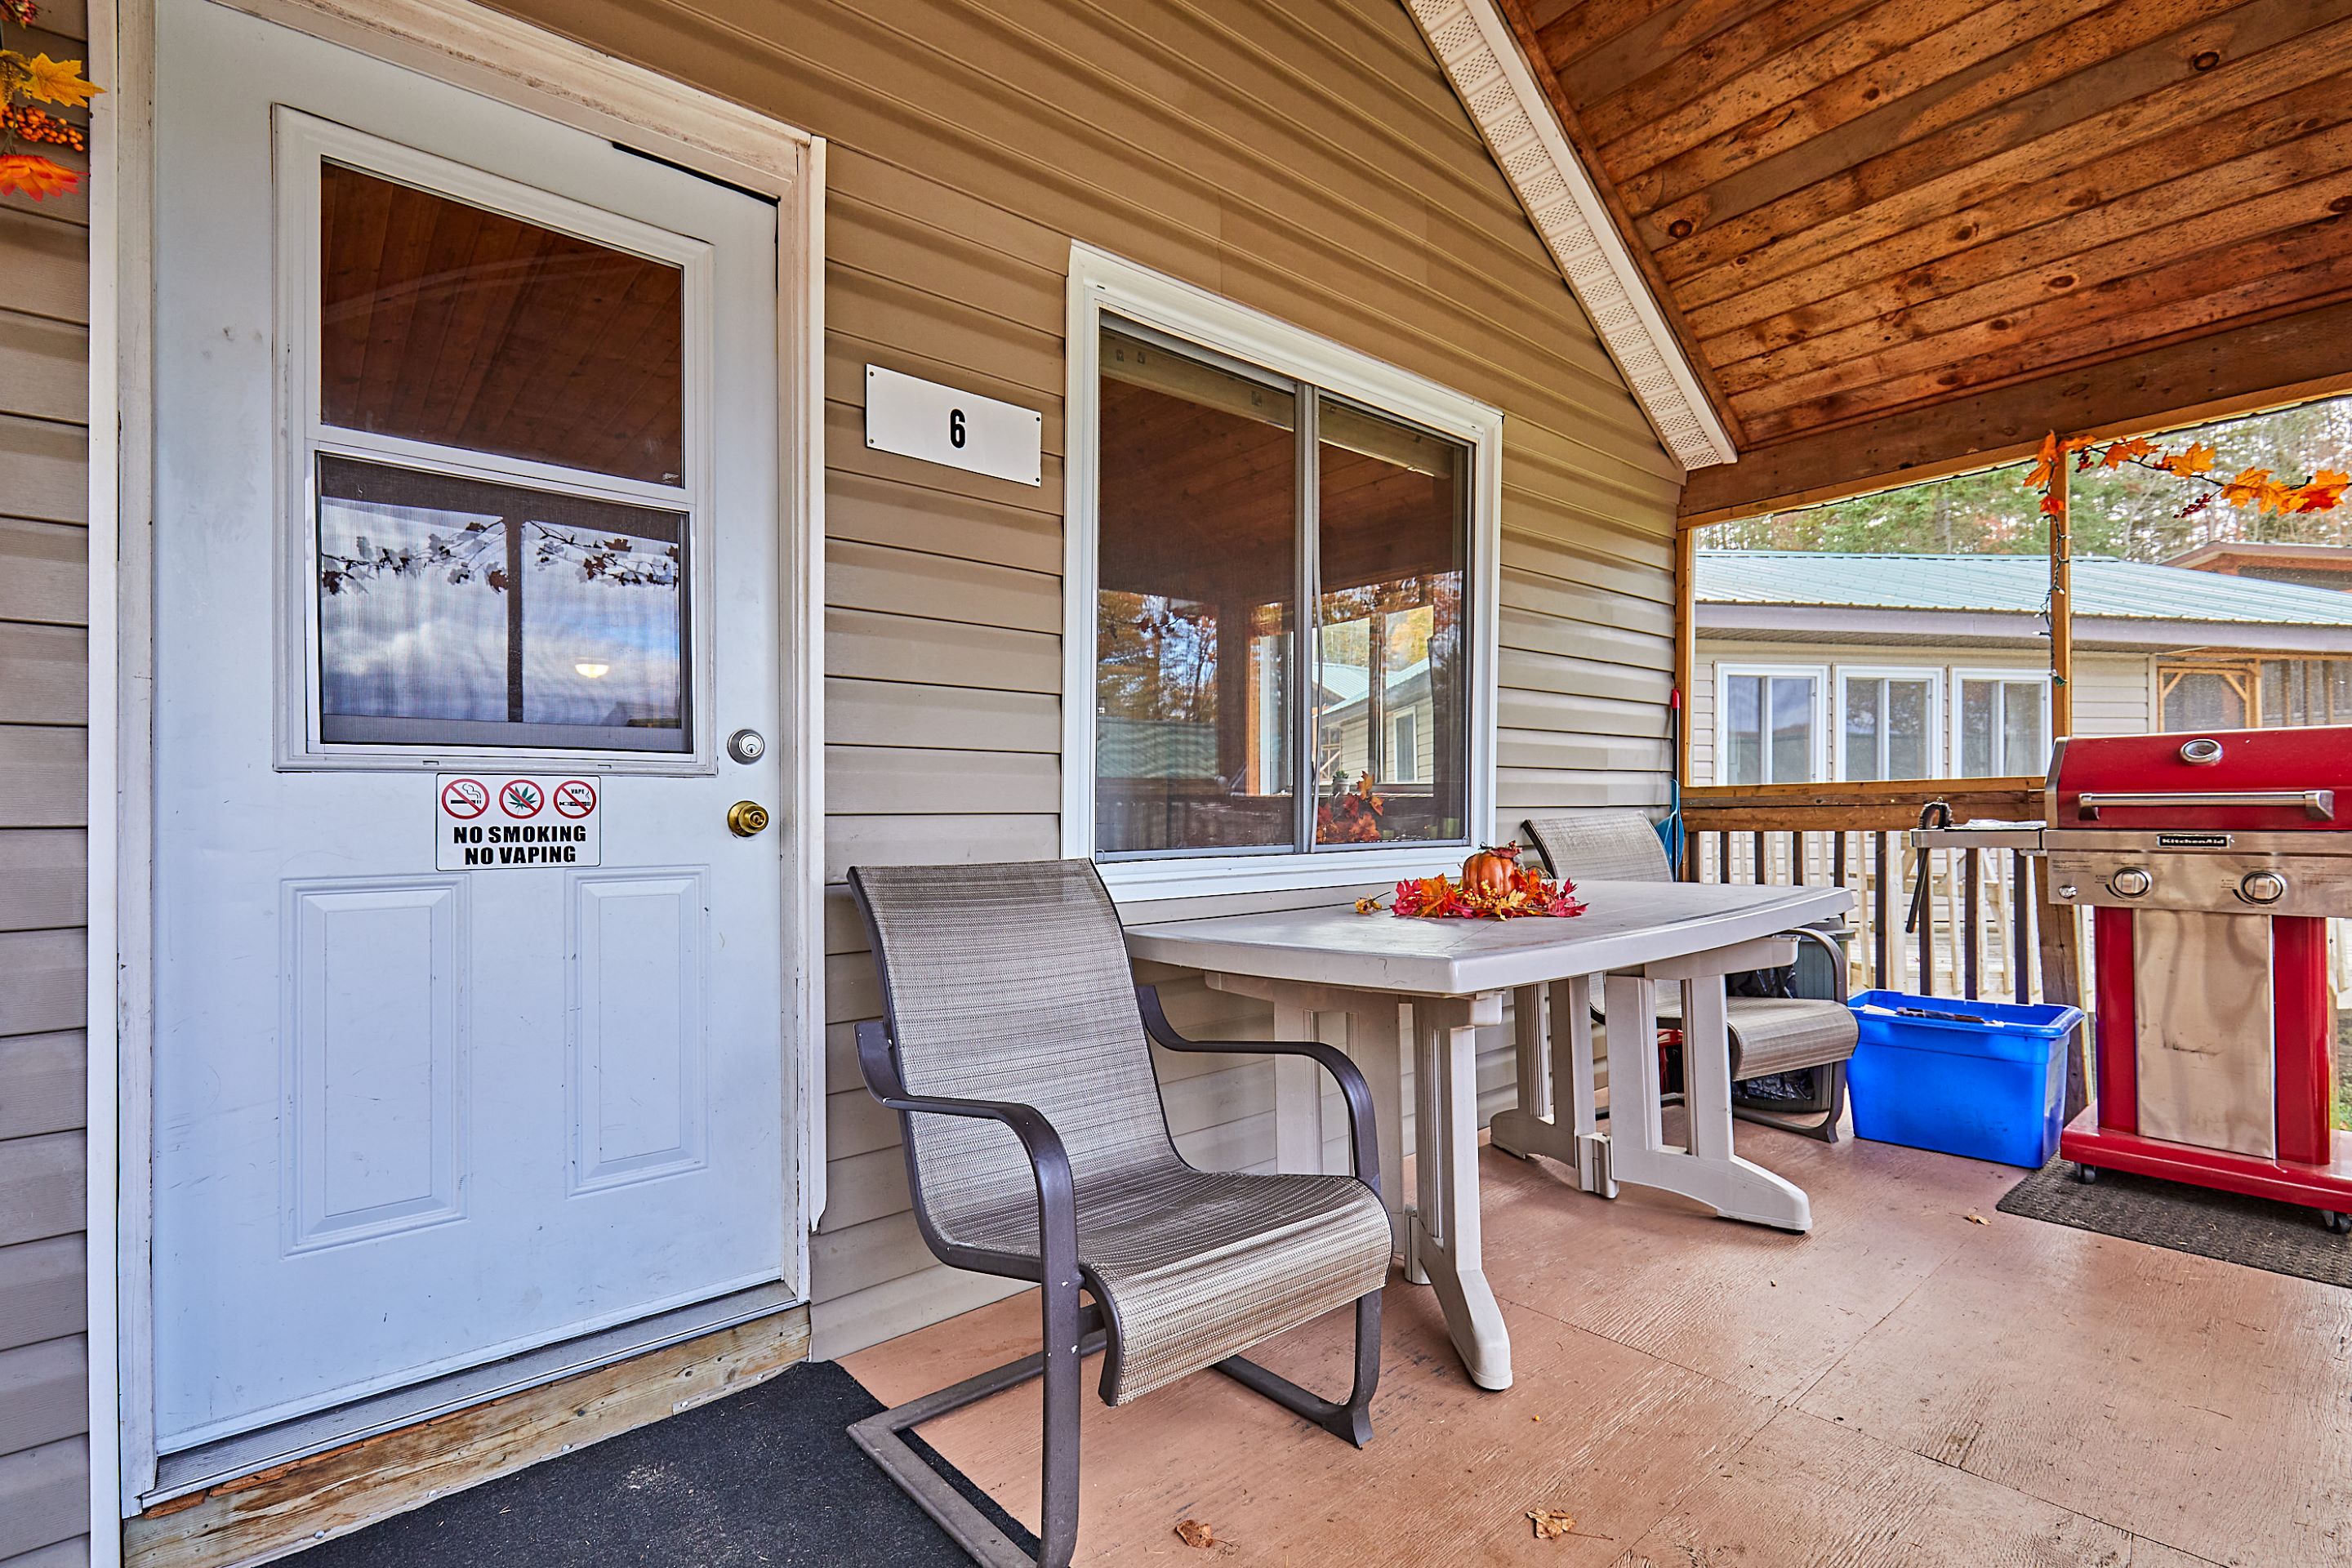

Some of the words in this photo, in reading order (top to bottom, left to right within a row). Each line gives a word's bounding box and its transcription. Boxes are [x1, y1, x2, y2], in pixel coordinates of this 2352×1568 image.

[950, 408, 966, 448] 6
[453, 826, 483, 844] NO
[488, 825, 586, 844] SMOKING
[465, 847, 494, 866] NO
[499, 845, 576, 865] VAPING
